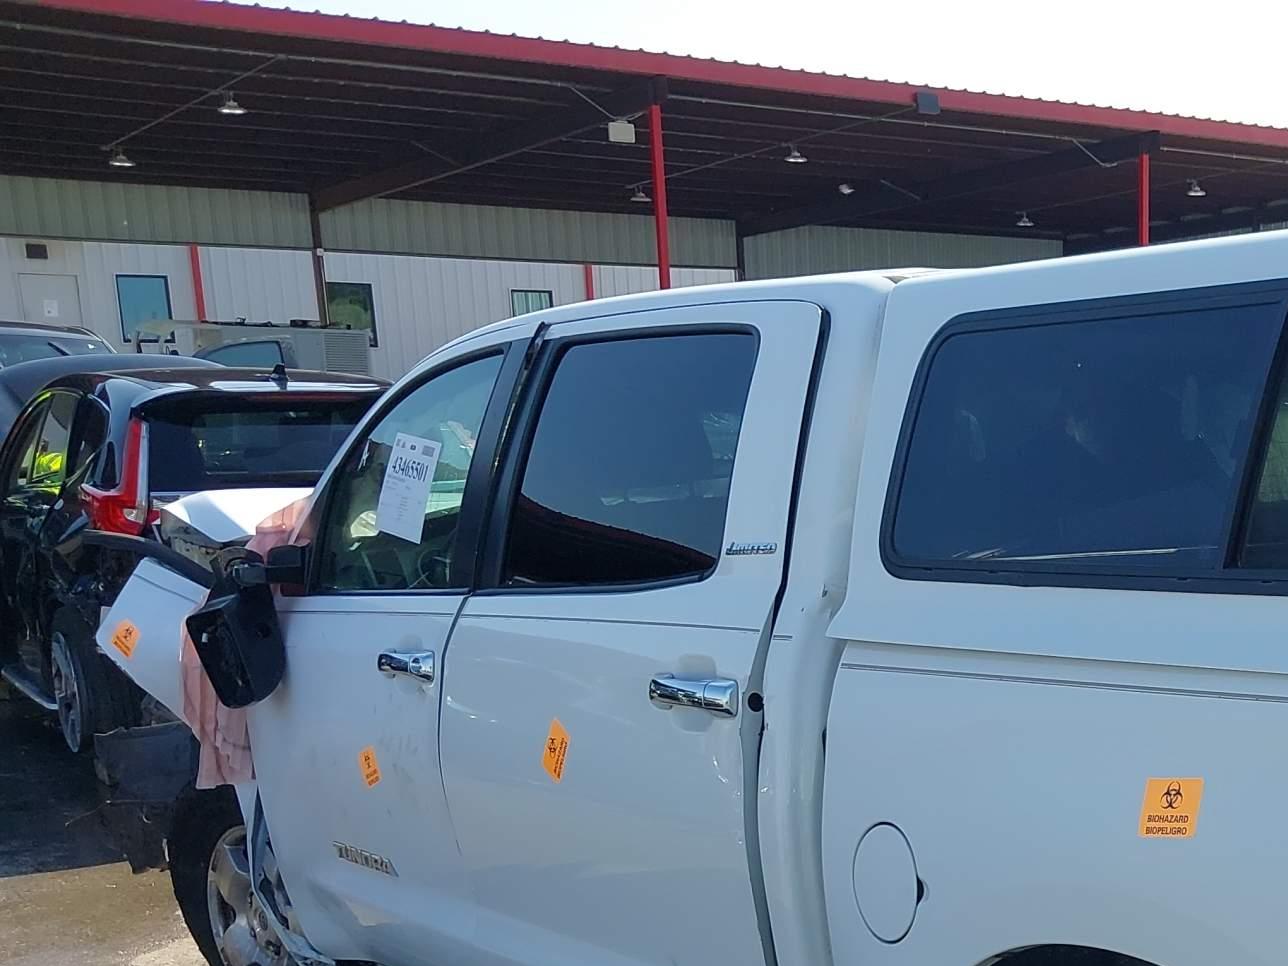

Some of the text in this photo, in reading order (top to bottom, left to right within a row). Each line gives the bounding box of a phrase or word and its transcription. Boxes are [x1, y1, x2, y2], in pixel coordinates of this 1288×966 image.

[392, 456, 429, 482] 43465501
[1146, 814, 1189, 824] BIOHAZARD
[1145, 826, 1187, 836] BIOPELIGRO
[332, 840, 399, 878] TUNDRA
